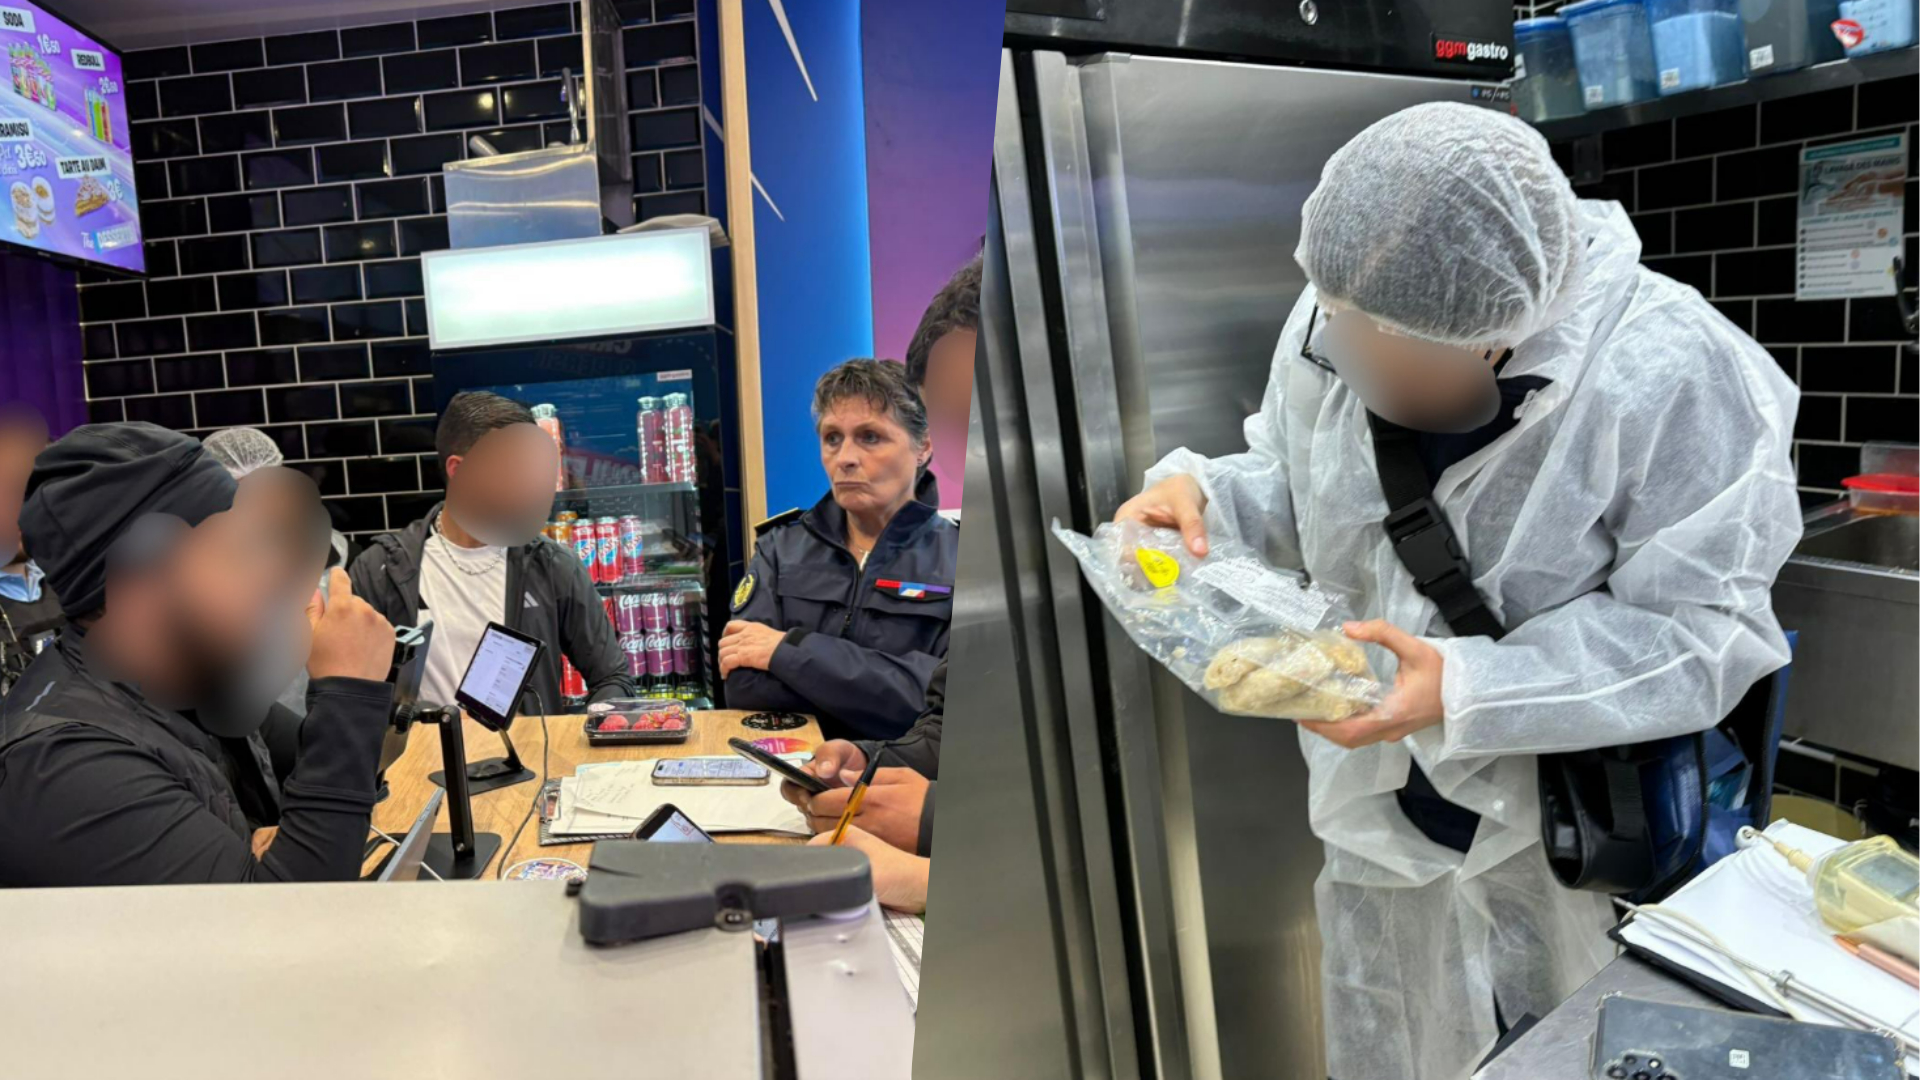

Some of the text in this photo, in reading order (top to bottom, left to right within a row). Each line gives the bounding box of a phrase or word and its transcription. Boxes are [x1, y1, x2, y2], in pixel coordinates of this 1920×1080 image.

[3, 11, 24, 27] SODA
[1436, 40, 1509, 61] ggmgastro
[15, 144, 47, 169] 3€50
[60, 160, 81, 174] TARTE
